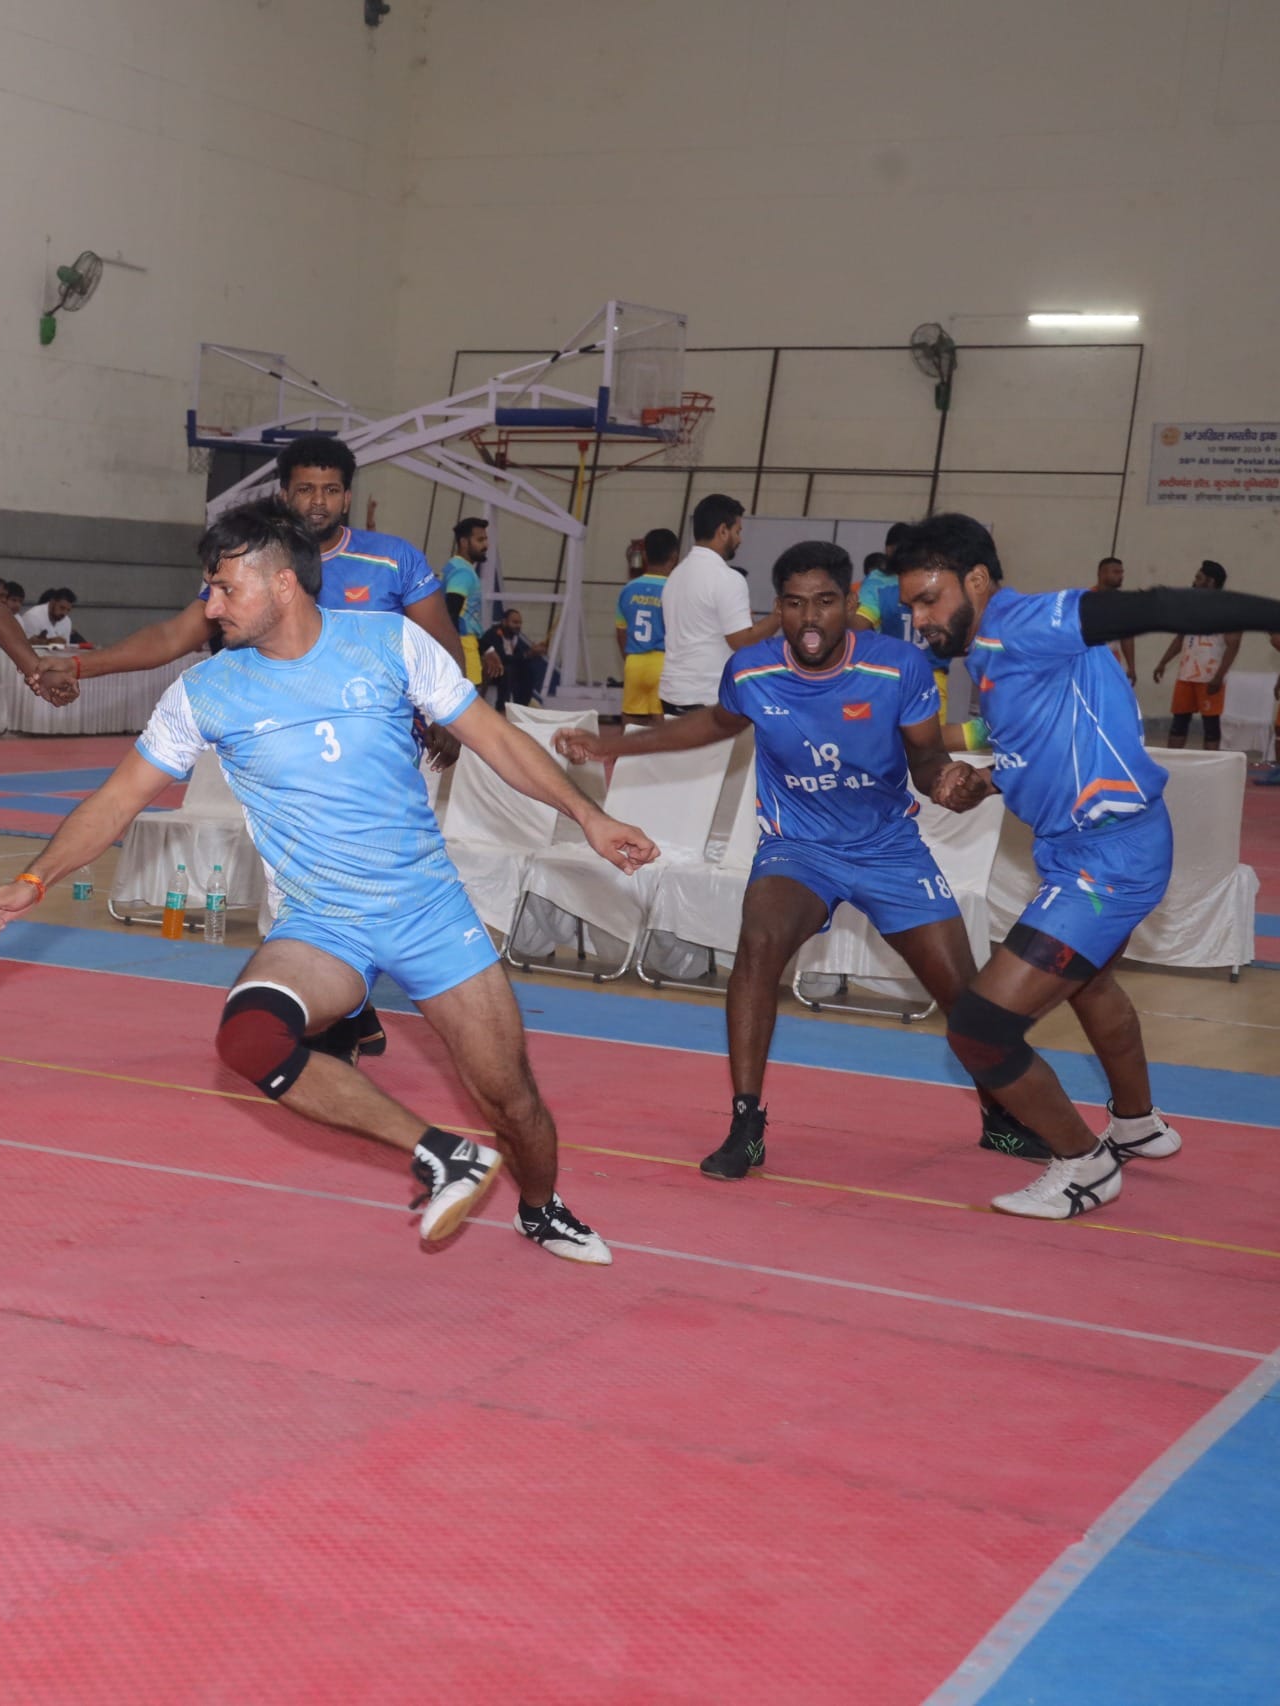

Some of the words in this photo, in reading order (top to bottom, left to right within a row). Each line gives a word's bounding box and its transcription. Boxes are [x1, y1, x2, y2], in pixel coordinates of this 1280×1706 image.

[634, 609, 652, 643] 5
[315, 720, 342, 762] 3
[783, 773, 876, 793] POSAL
[917, 874, 953, 900] 18
